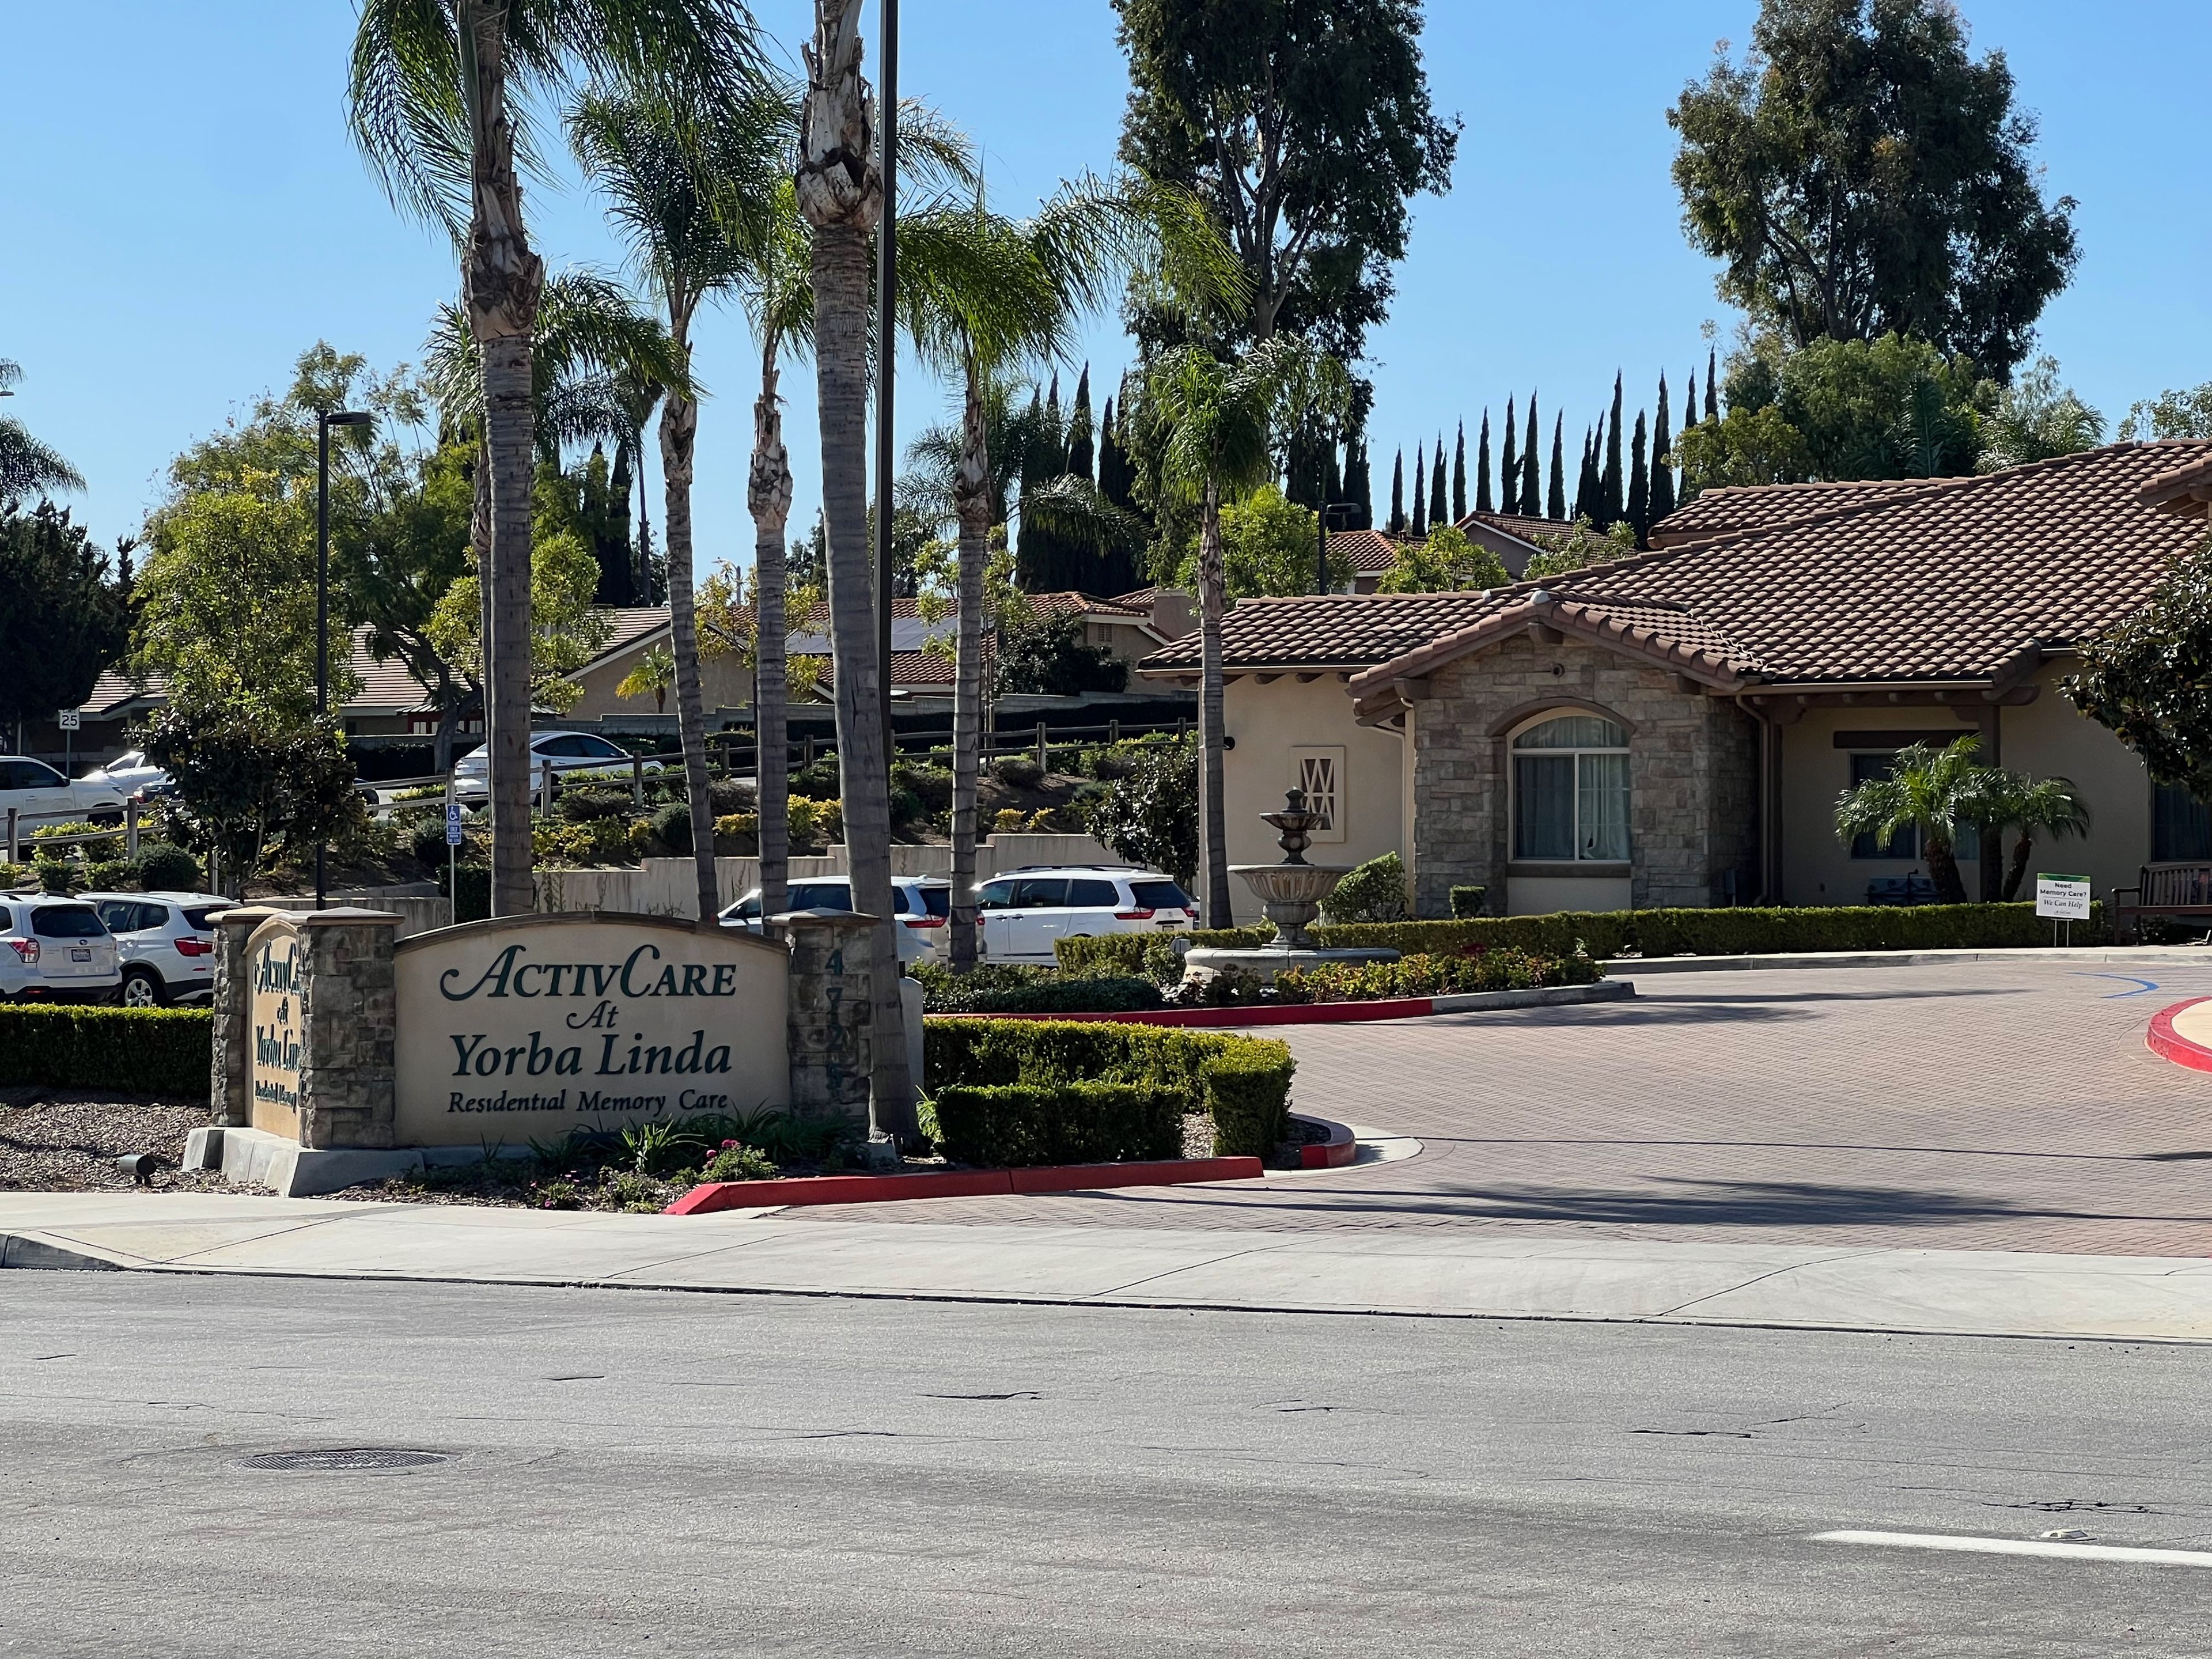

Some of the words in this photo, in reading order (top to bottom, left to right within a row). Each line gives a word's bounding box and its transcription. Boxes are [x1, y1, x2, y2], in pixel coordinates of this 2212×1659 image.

[62, 715, 77, 726] 25
[2040, 889, 2067, 897] Memory
[2068, 901, 2083, 910] Help
[566, 1000, 619, 1029] At
[449, 1031, 583, 1076] Yorba
[594, 1029, 732, 1075] Linda
[446, 1089, 566, 1113] Residential
[576, 1090, 666, 1116] Memory
[679, 1089, 728, 1109] Care
